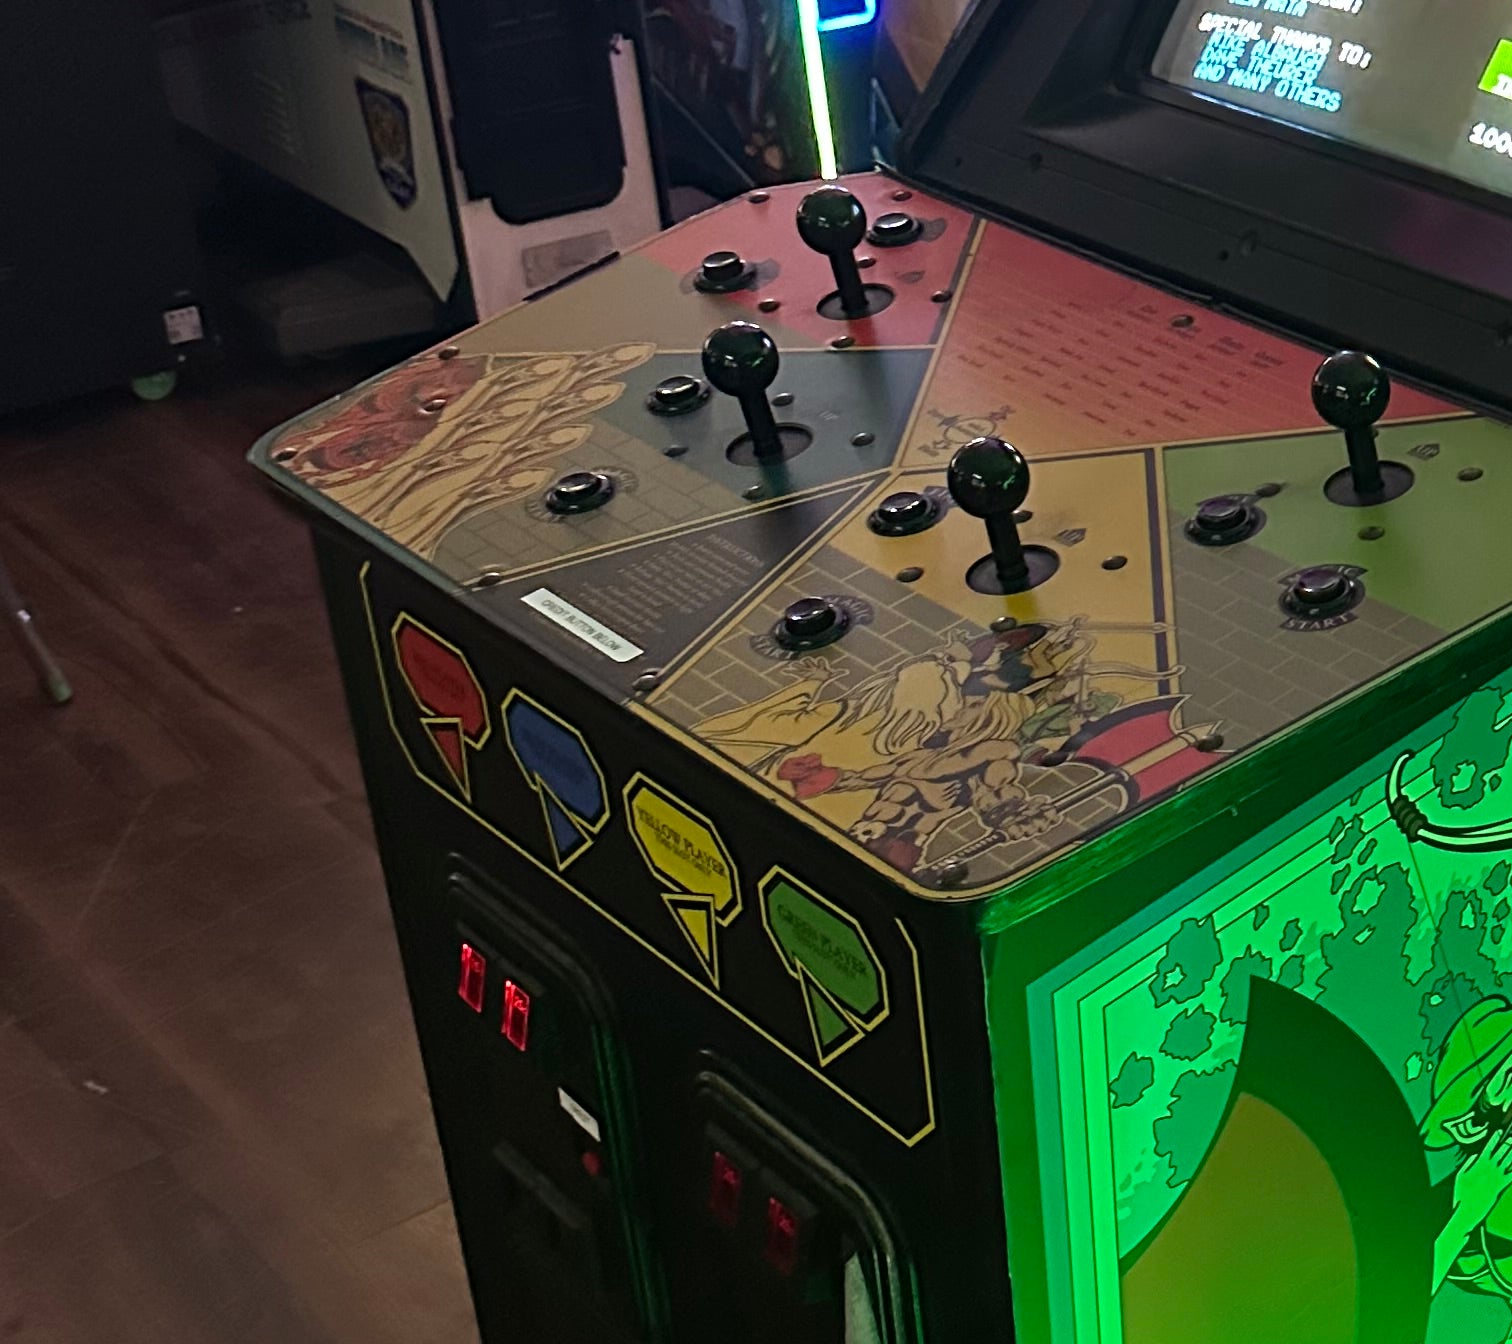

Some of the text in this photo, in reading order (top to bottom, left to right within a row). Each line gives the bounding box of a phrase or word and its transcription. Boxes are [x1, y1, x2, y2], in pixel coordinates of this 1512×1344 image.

[1338, 41, 1373, 70] TO:
[1194, 61, 1343, 113] AND MANY OTHERS
[1286, 613, 1350, 631] START
[592, 631, 622, 652] BELOW
